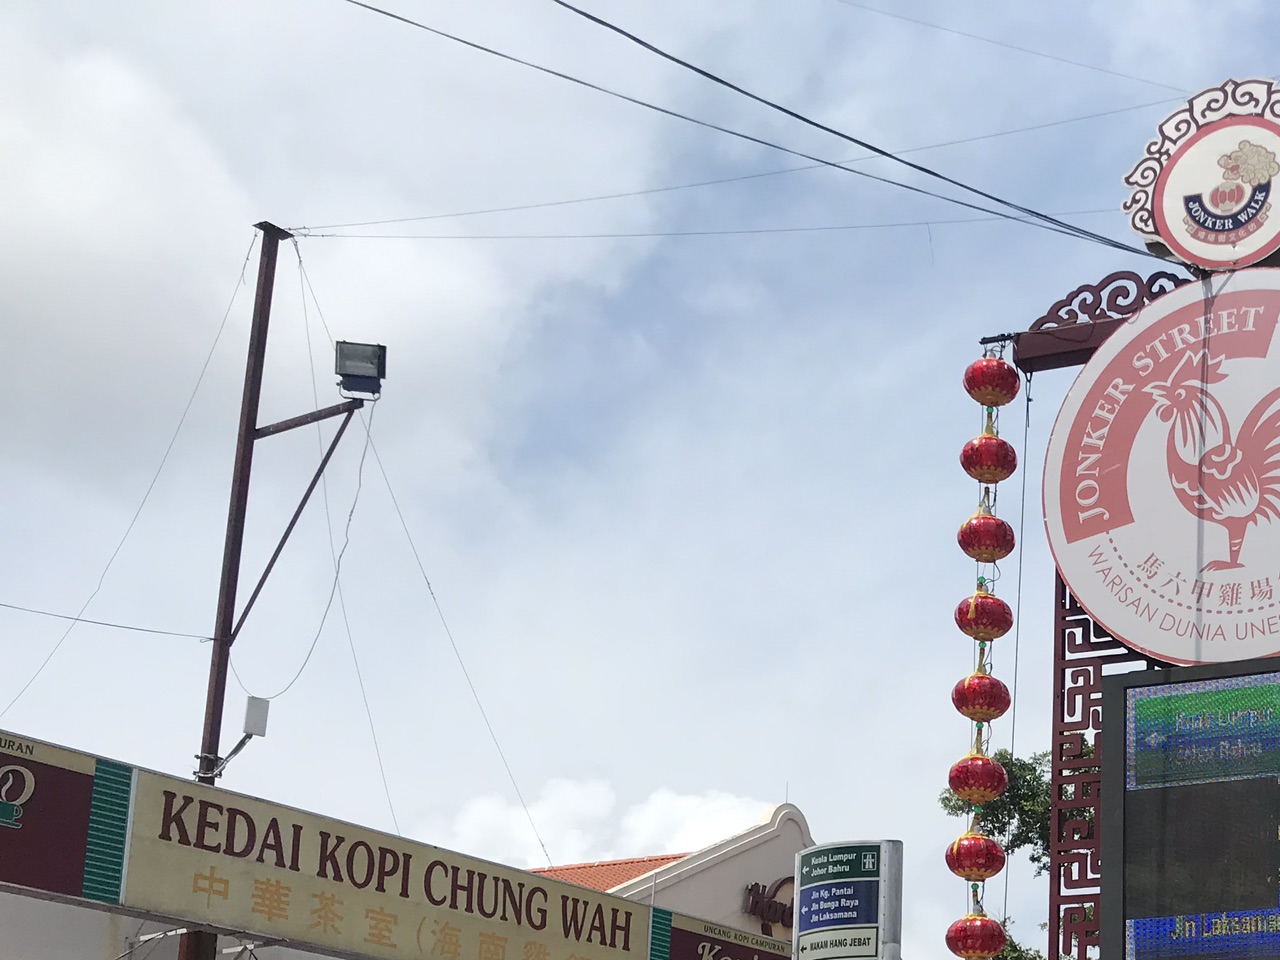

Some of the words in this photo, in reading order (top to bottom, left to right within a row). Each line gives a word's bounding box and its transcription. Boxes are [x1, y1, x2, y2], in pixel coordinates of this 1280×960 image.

[1188, 201, 1233, 230] JONKER
[1237, 190, 1266, 223] WALK
[1075, 378, 1135, 524] JONKER
[1132, 306, 1264, 377] STREET
[1088, 545, 1159, 622] WARISAN
[1159, 613, 1226, 641] DUNIA
[811, 855, 828, 866] Kuala
[829, 852, 857, 863] Lumpur
[158, 790, 303, 871] KEDAI
[316, 831, 412, 899] KOPI
[424, 860, 548, 931] CHUNG
[561, 895, 633, 951] WAH
[811, 866, 827, 877] Johor
[828, 865, 850, 874] Bahru
[811, 890, 819, 900] Jln
[831, 886, 854, 896] Pantai
[840, 899, 859, 909] Raya
[819, 910, 858, 921] Laksamana
[704, 925, 731, 939] UNCANG
[733, 933, 750, 944] KOPI
[751, 937, 785, 952] CAMPURAN
[809, 940, 828, 951] MAKAM
[829, 939, 847, 949] HANG
[849, 938, 871, 947] JEBAT
